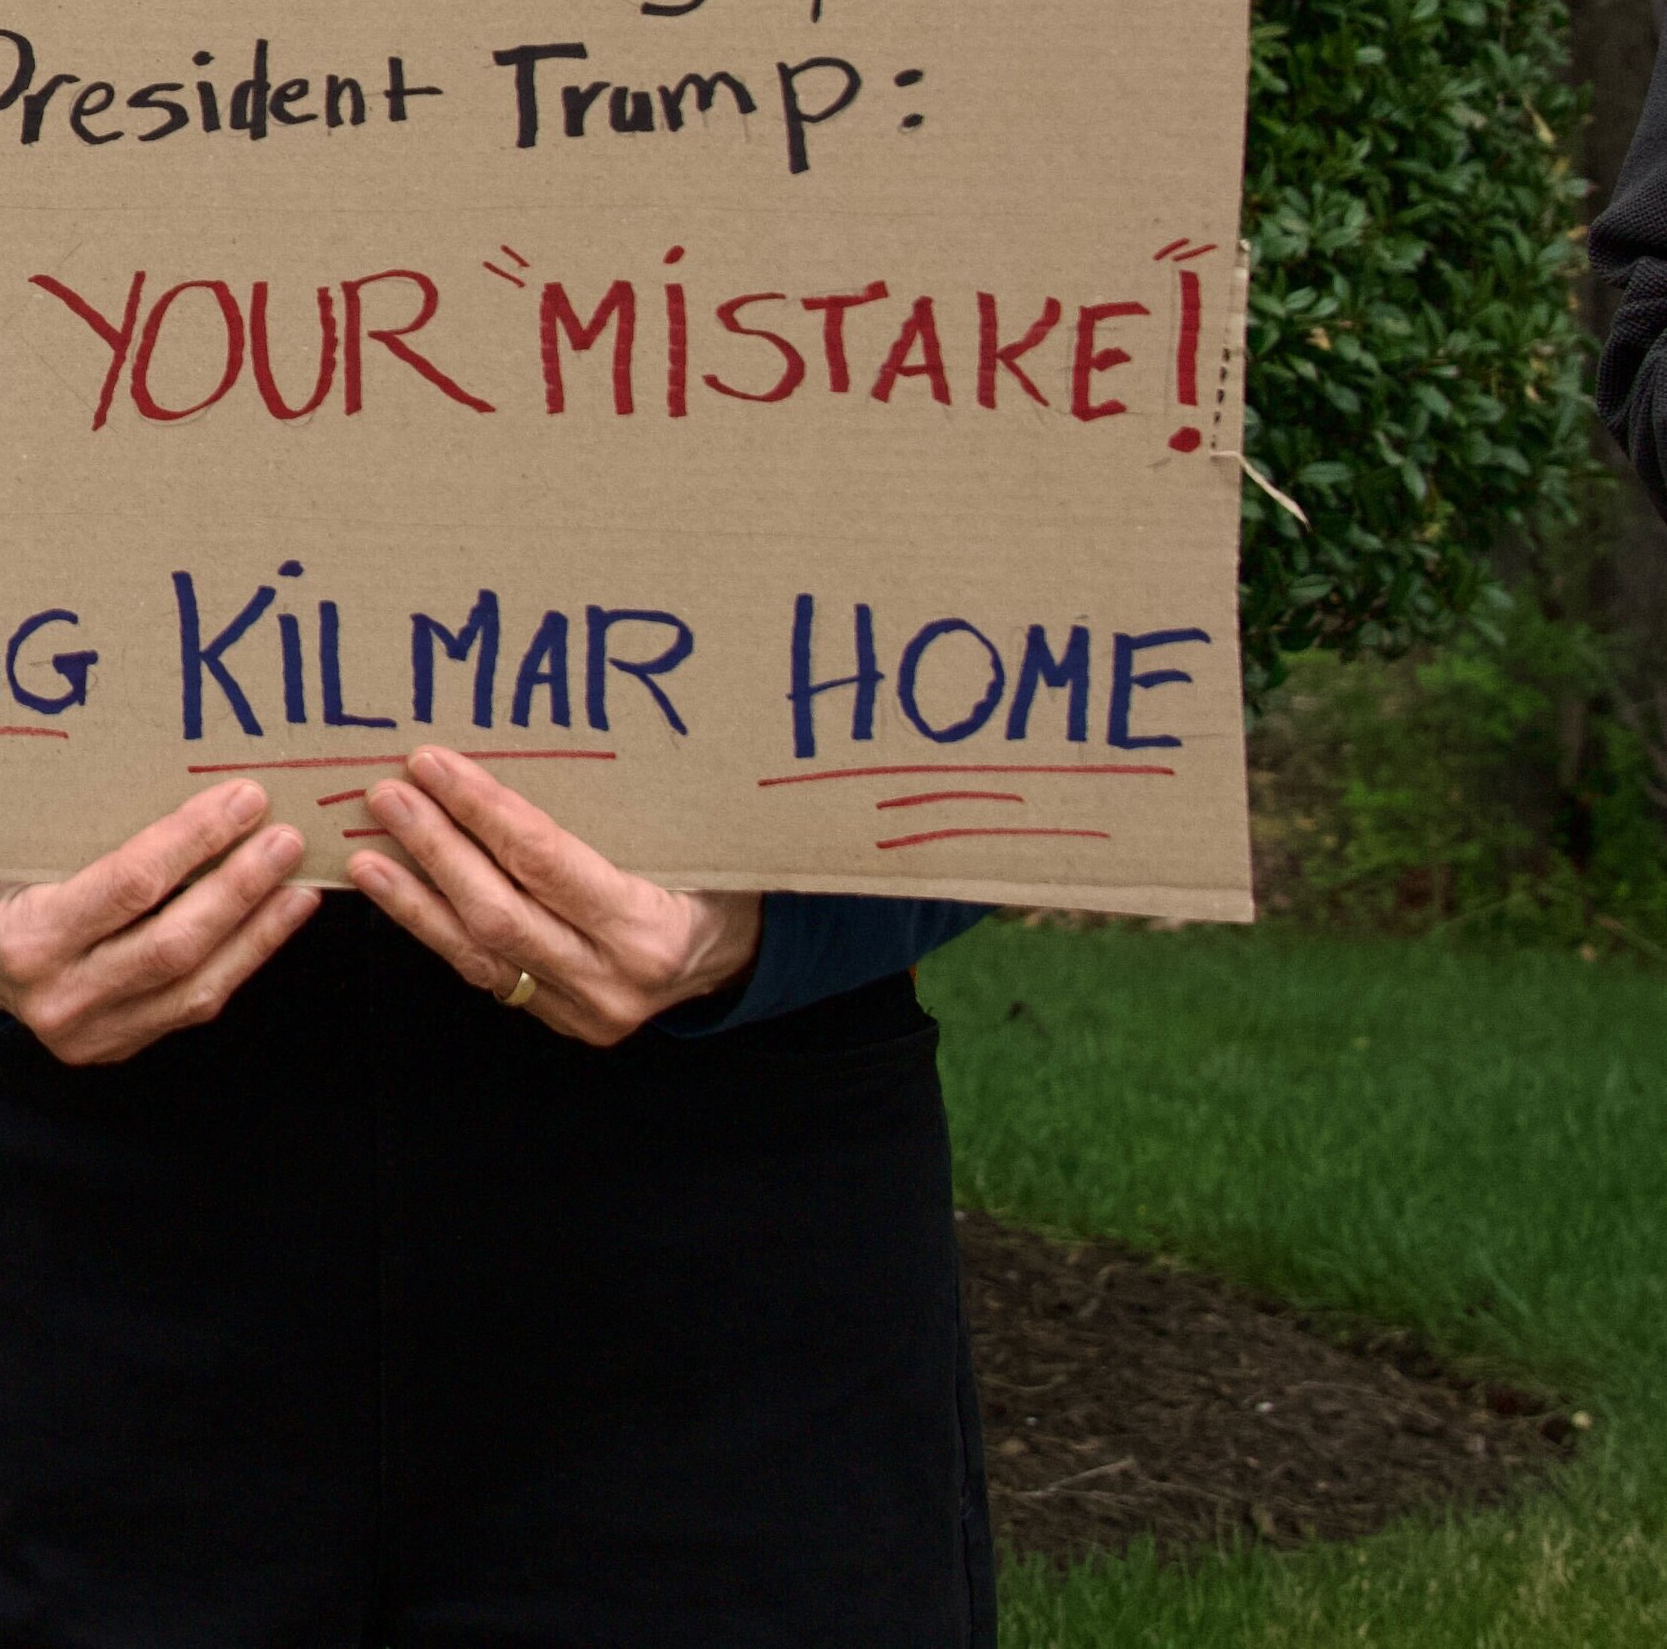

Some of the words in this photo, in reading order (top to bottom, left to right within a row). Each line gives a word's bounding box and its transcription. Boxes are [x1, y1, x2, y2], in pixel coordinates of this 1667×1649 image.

[492, 42, 925, 175] Trump:
[28, 269, 496, 432] YOUR
[786, 593, 1212, 759] HOME
